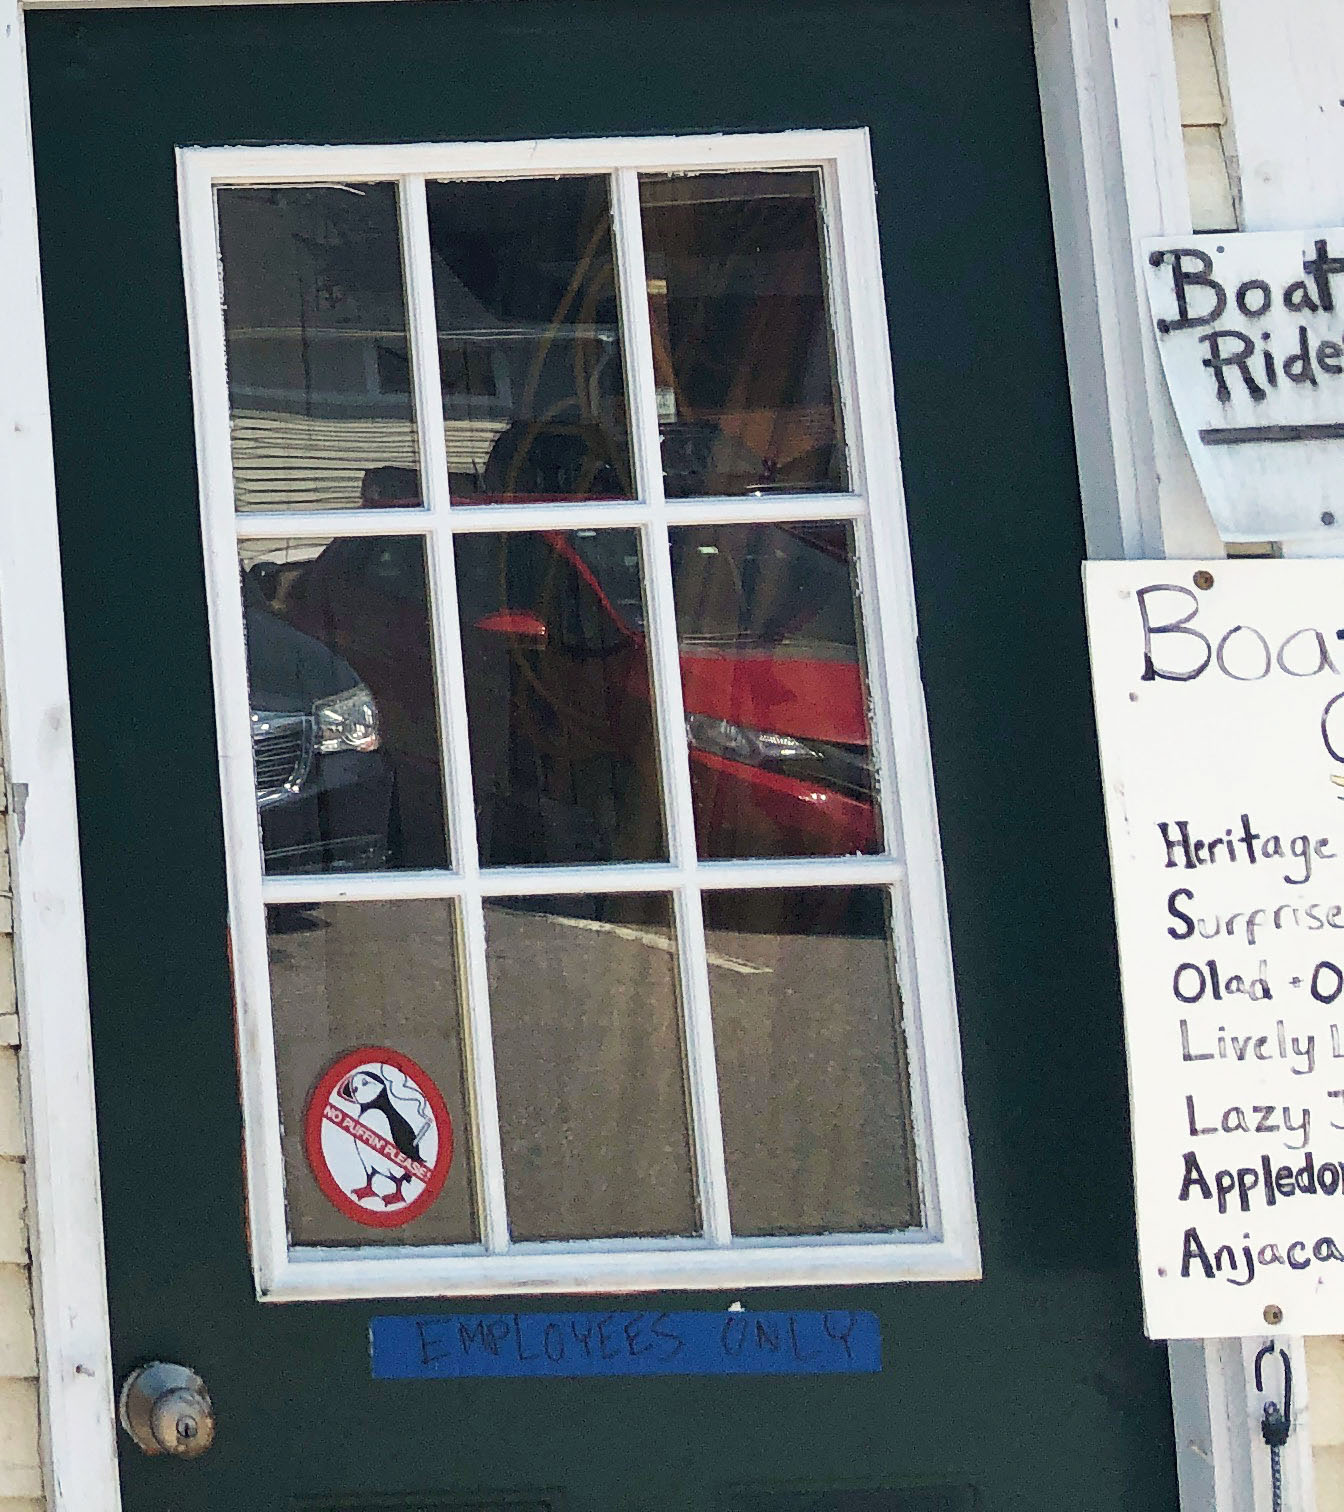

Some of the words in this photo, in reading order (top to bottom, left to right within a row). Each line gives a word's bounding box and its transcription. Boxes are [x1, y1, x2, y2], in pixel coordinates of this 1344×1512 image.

[1149, 239, 1344, 333] Boat
[1198, 326, 1344, 403] Ride
[1136, 584, 1344, 681] Boa
[1157, 814, 1337, 884] Heritage
[1172, 959, 1273, 1004] Olad
[1179, 1018, 1316, 1076] Lively
[323, 1104, 343, 1123] NO
[1185, 1094, 1311, 1150] Lazy
[415, 1312, 686, 1366] EMPLOYEES
[720, 1313, 857, 1362] ONLY
